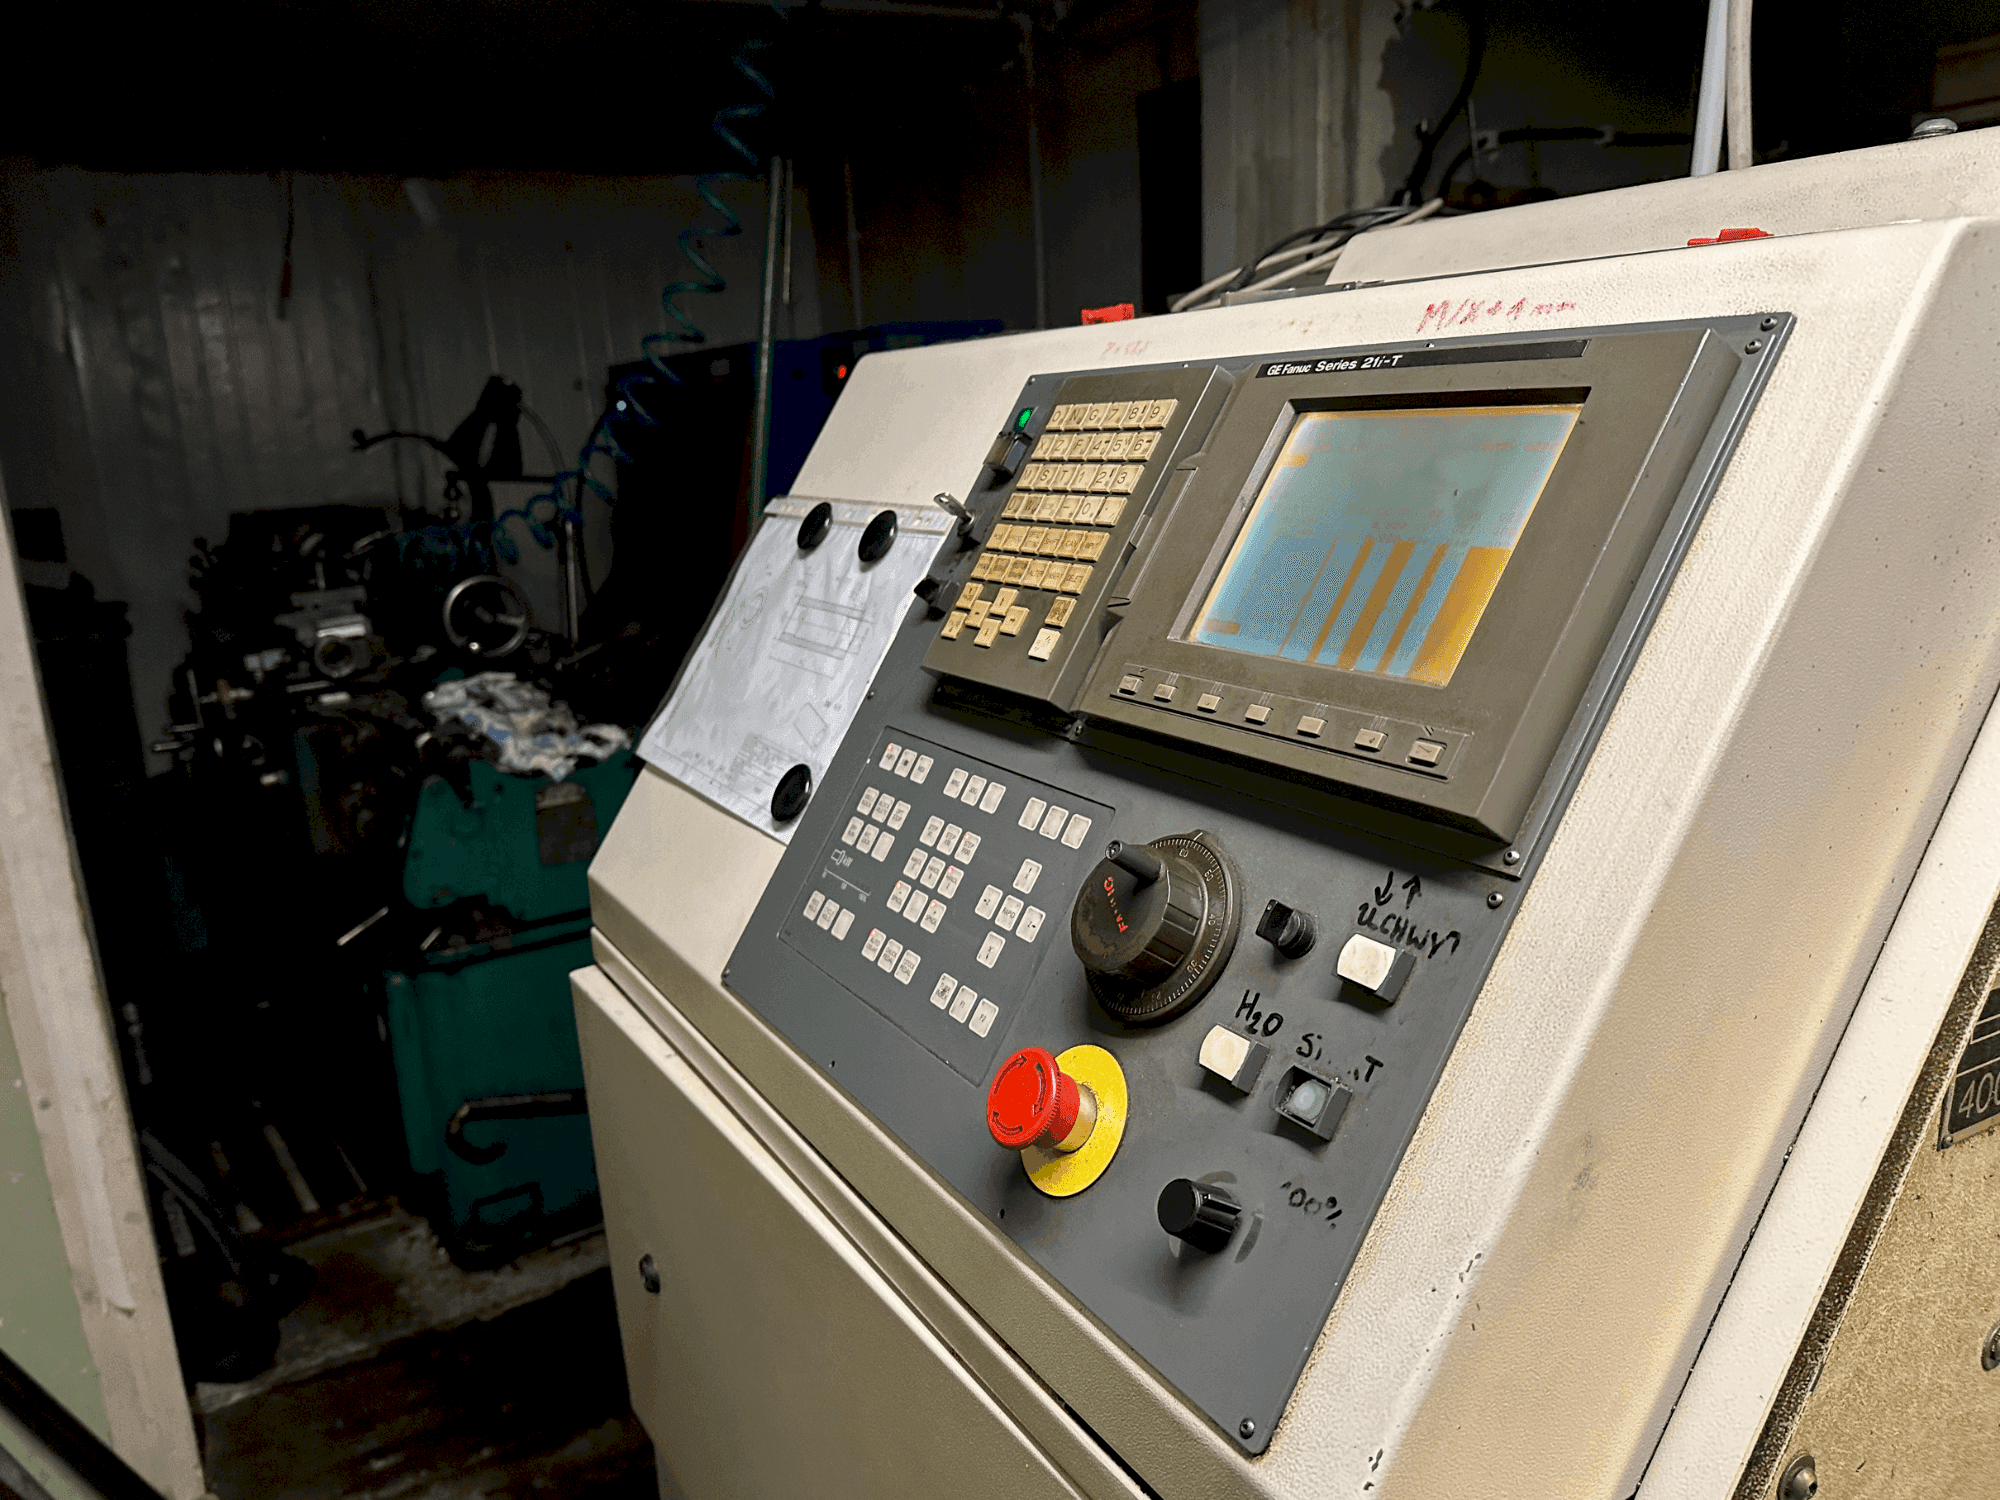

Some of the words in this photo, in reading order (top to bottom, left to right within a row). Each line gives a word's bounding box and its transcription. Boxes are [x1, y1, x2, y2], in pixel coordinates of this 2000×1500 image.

[1267, 364, 1283, 376] GE
[1282, 363, 1312, 374] Fanuc
[1315, 360, 1357, 372] Series
[1361, 355, 1403, 368] 21i-T
[1089, 409, 1100, 420] G
[1108, 408, 1119, 420] 7
[1129, 407, 1139, 419] 8
[1150, 406, 1161, 418] 9
[1055, 440, 1064, 451] Z
[1075, 440, 1084, 450] F
[1093, 440, 1102, 450] 4
[1113, 440, 1123, 451] 5
[1133, 439, 1144, 450] 6
[1040, 470, 1050, 481] S
[1060, 470, 1068, 481] T
[1079, 472, 1085, 481] 1
[1096, 472, 1106, 484] 2
[1117, 472, 1127, 484] 3
[928, 824, 939, 832] STEP
[963, 841, 974, 849] STEP
[1002, 907, 1016, 918] RAPID
[1208, 914, 1216, 926] 40
[882, 954, 894, 964] PEDAL
[899, 964, 911, 976] PEDAL
[1186, 959, 1198, 973] 30
[979, 1014, 986, 1022] F2
[1235, 988, 1285, 1037] H2O
